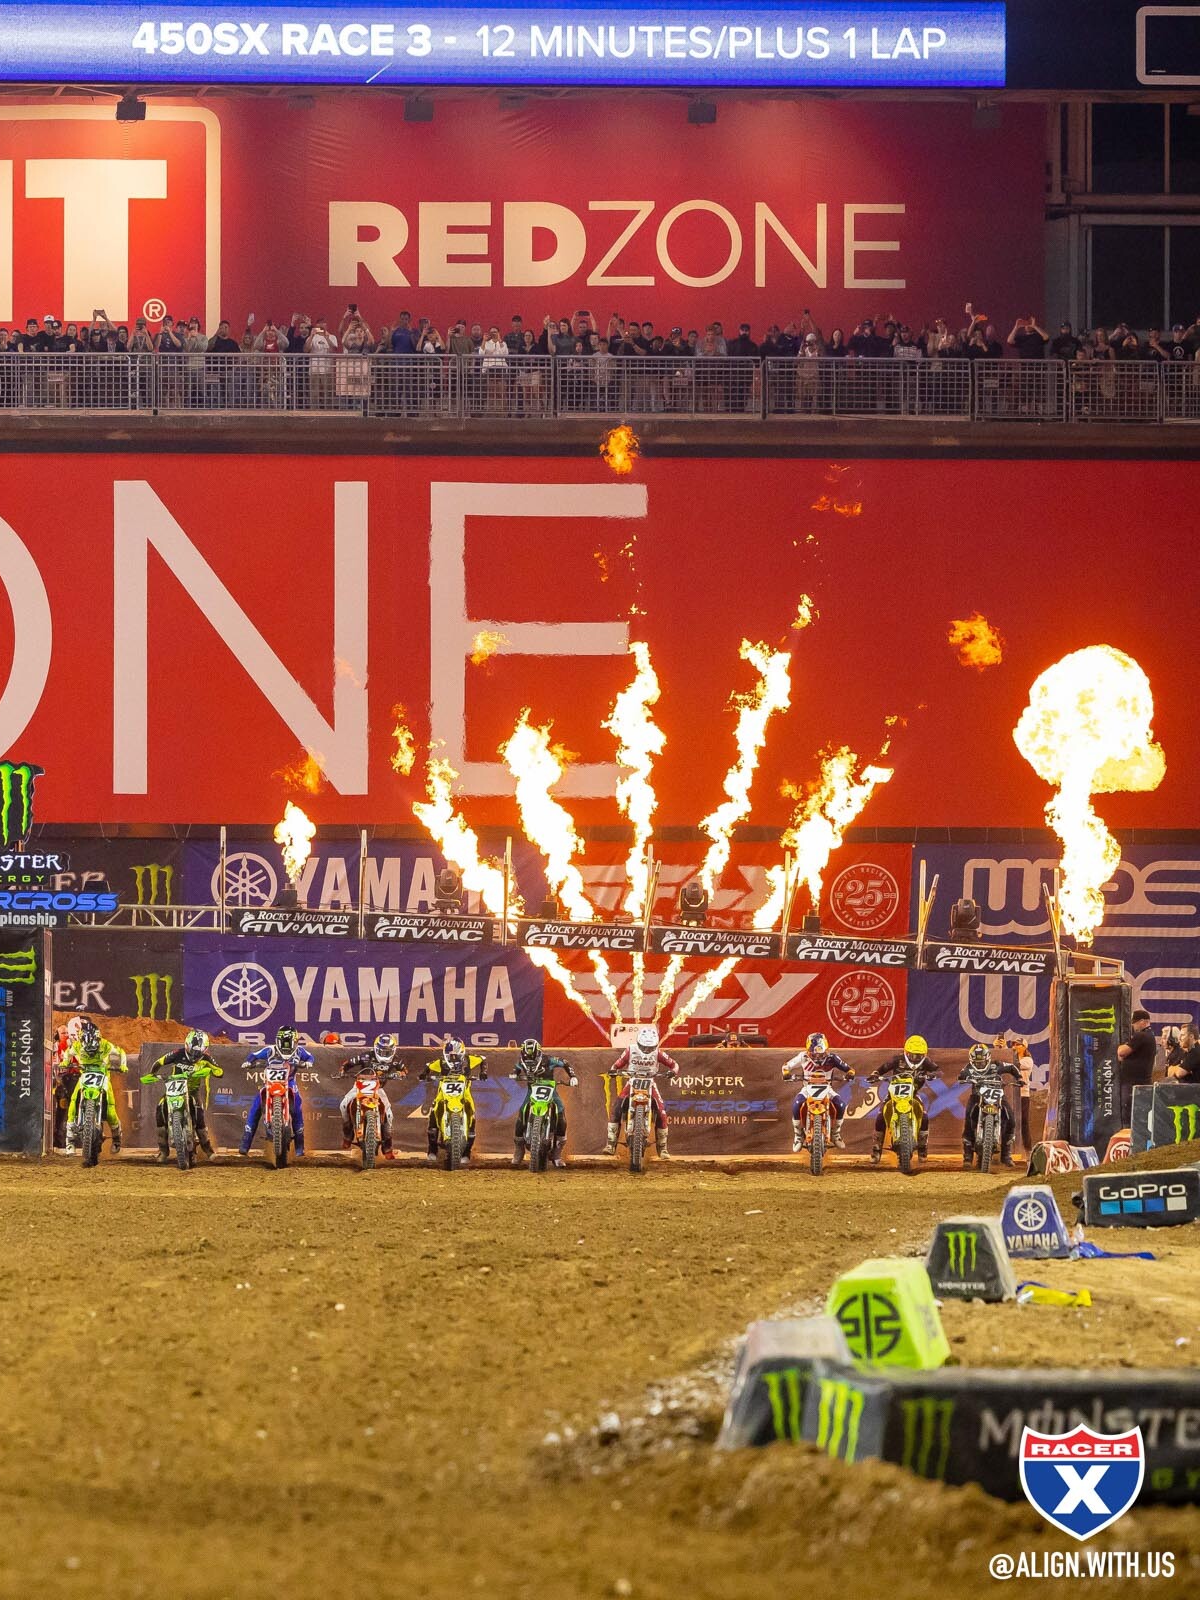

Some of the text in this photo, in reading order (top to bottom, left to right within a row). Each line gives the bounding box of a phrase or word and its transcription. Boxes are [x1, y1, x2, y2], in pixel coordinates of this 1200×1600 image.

[133, 23, 270, 56] 450SX
[283, 23, 394, 56] RACE
[405, 24, 432, 56] 3
[476, 25, 515, 57] 12
[530, 25, 831, 60] MINUTES/PLUS
[844, 27, 857, 58] 1
[871, 28, 946, 60] LAP
[328, 199, 907, 289] REDZONE
[845, 880, 884, 906] 25
[256, 910, 350, 923] ROCKY MOUNTAIN
[392, 916, 484, 929] ROCKY MOUNTAIN
[543, 924, 635, 937] ROCKY MOUNTAIN
[679, 931, 771, 943] ROCKY MOUNTAIN
[814, 939, 906, 952] ROCKY MOUNTAIN
[954, 947, 1046, 961] ROCKY MOUNTAIN
[283, 966, 516, 1023] YAMAHA
[842, 987, 880, 1014] 25
[19, 1019, 31, 1099] MONSTER
[84, 1074, 102, 1085] 21
[269, 1070, 288, 1080] 23
[670, 1075, 744, 1088] MONSTER
[168, 1081, 186, 1093] 47
[361, 1080, 377, 1092] 2
[446, 1083, 462, 1093] 94
[811, 1086, 827, 1097] 7
[894, 1085, 910, 1095] 12
[1103, 1059, 1113, 1117] MONSTER
[983, 1088, 1000, 1099] 46
[666, 1116, 747, 1125] CHAMPIONSHIP
[1099, 1183, 1186, 1200] GoPro
[1006, 1231, 1060, 1249] YAMAHA
